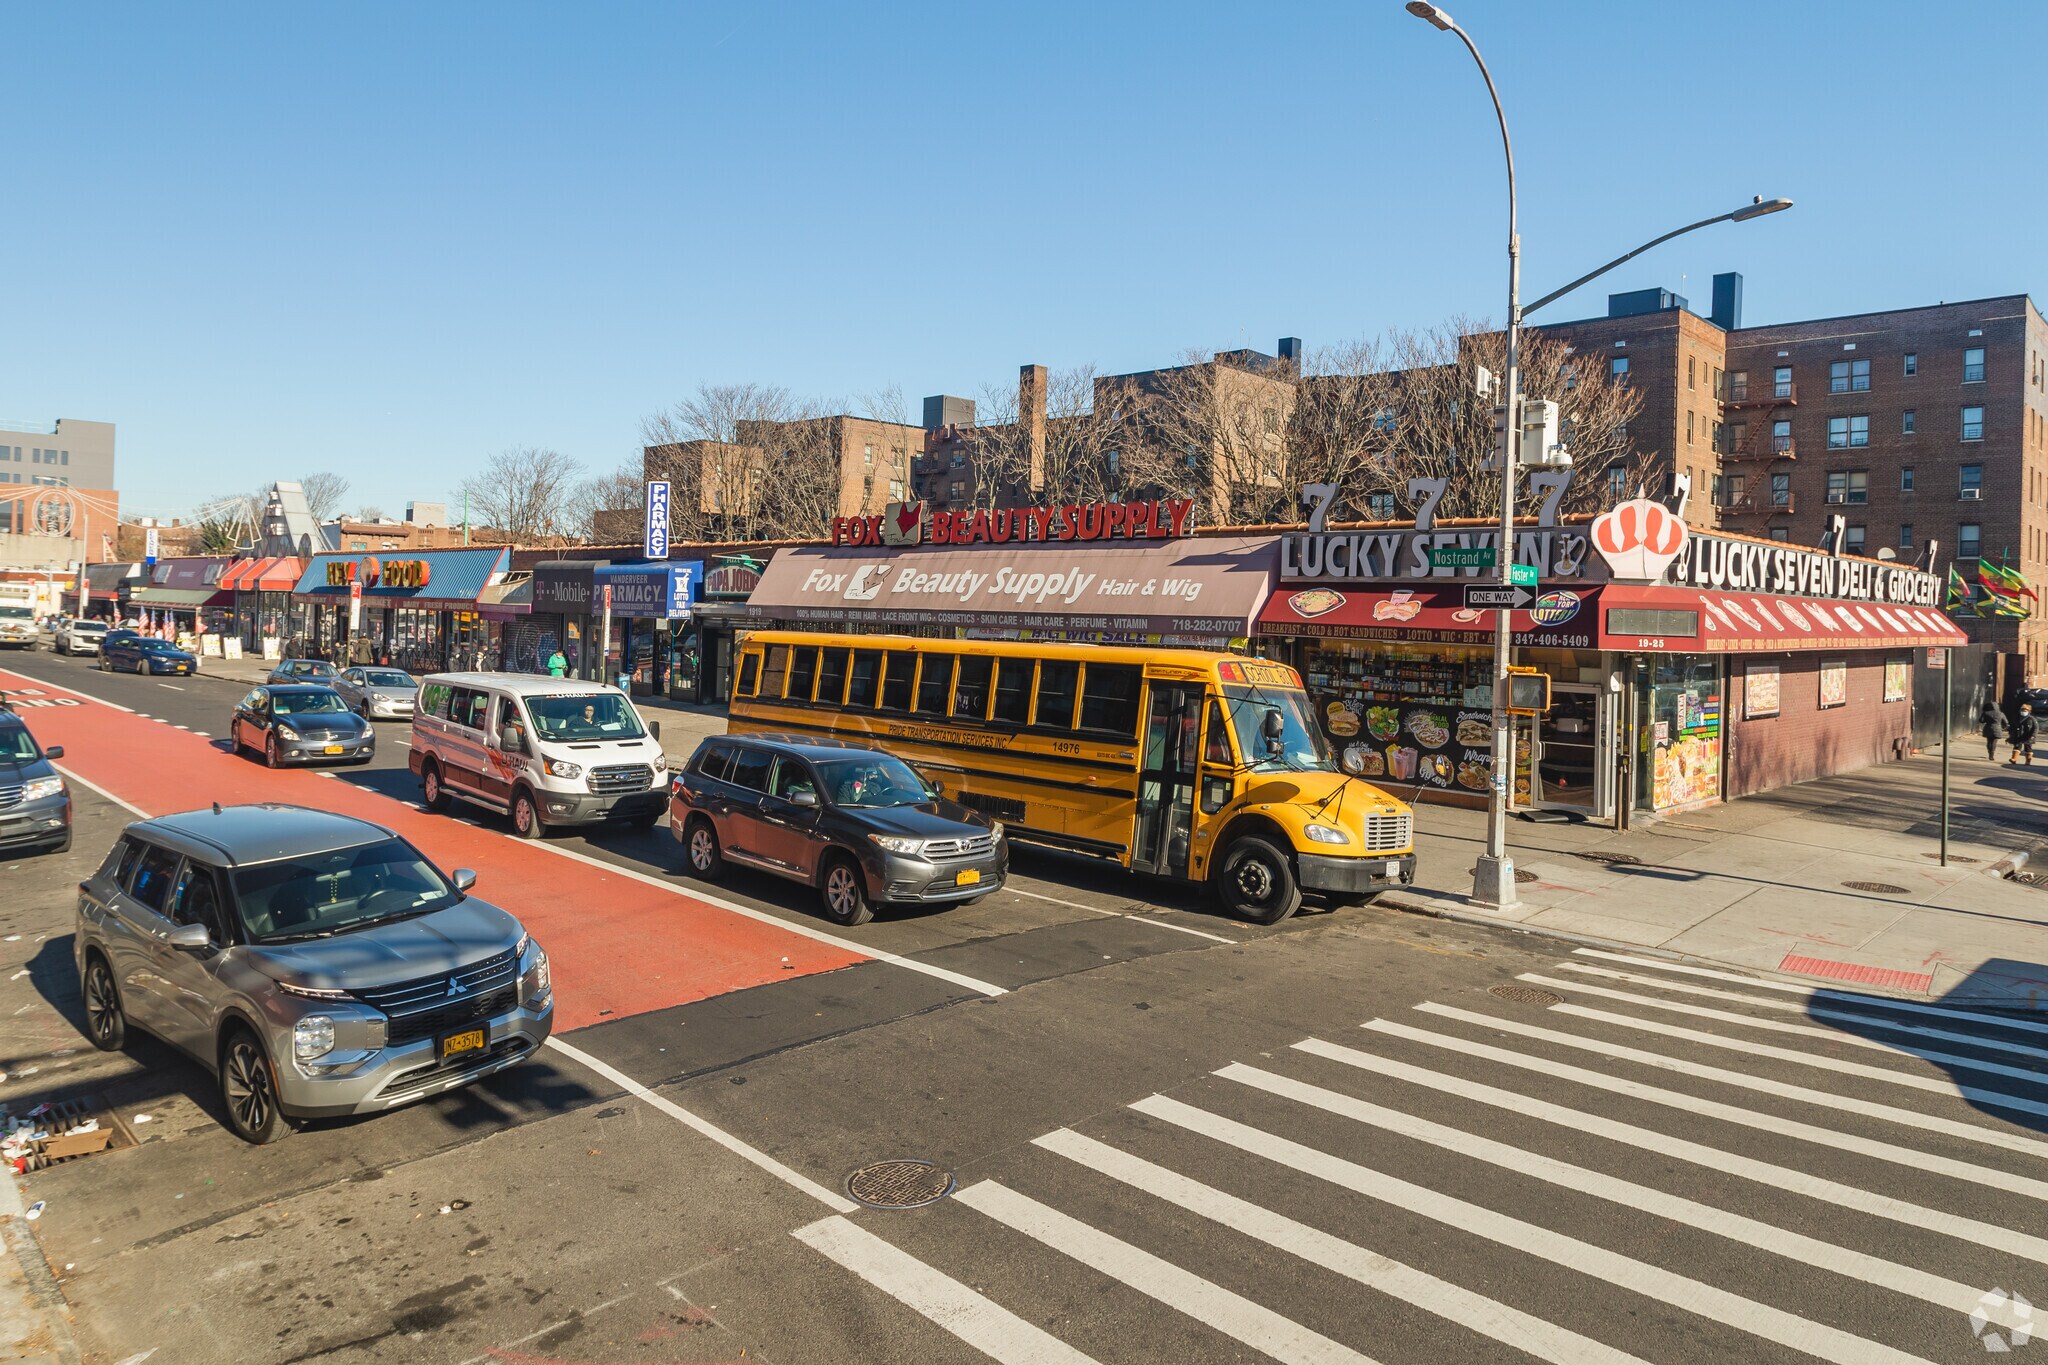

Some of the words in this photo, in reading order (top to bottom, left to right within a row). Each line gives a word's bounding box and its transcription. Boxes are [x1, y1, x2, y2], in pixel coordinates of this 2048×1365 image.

[1303, 482, 1341, 532] 7
[1408, 477, 1450, 530] 7
[1531, 470, 1575, 527] 7
[651, 484, 666, 556] PHARMACY
[832, 515, 884, 546] FOX
[931, 506, 1055, 544] BEAUTY
[1058, 499, 1194, 541] SUPPLY
[1832, 514, 1846, 557] 7
[1281, 534, 1403, 578] LUCKY
[1434, 551, 1478, 565] Nostrand
[1483, 551, 1491, 560] Av
[326, 562, 358, 587] KEY
[383, 560, 431, 588] FOOD
[610, 574, 648, 584] VANDERVEER
[1512, 567, 1529, 583] Foster
[1695, 538, 1772, 588] LUCKY
[1773, 549, 1835, 595] SEVEN
[1838, 559, 1871, 598] DELI
[1875, 569, 1884, 599] &
[1888, 571, 1941, 605] GROCERY
[707, 569, 730, 592] PAPA
[801, 568, 848, 593] Fox
[891, 568, 989, 603] Beauty
[988, 567, 1096, 604] Supply
[1097, 579, 1140, 596] Hair
[1140, 578, 1157, 596] &
[1161, 578, 1203, 601] Wig
[673, 593, 689, 601] LOTTO
[676, 601, 686, 609] FAX
[1472, 592, 1491, 602] ONE
[1494, 592, 1515, 602] WAY
[1557, 600, 1576, 608] YORK
[424, 601, 443, 609] FRESH
[444, 602, 474, 611] PRODUCE
[810, 610, 830, 619] HUMAN
[830, 610, 844, 619] HAIR
[848, 611, 861, 620] REMI
[863, 611, 877, 620] HAIR
[882, 612, 897, 620] LACE
[898, 612, 918, 621] FRONT
[919, 613, 932, 622] WIG
[938, 613, 975, 623] COSMETICS
[980, 614, 998, 624] SKIN
[999, 615, 1018, 625] CARE
[1024, 616, 1042, 626] HAIR
[1043, 616, 1064, 627] CARE
[1070, 617, 1107, 628] PERFUME
[1113, 618, 1148, 629] VITAMIN
[1533, 609, 1575, 621] LOTTERY
[1172, 619, 1242, 632] 718-282-0707
[1262, 623, 1301, 634] BREAKFAST
[1307, 625, 1326, 636] COLD
[1326, 627, 1332, 636] &
[1333, 627, 1349, 637] HOT
[1350, 628, 1398, 639] SANDWICHES
[1406, 630, 1433, 640] LOTTO
[1440, 631, 1456, 642] WIC
[1463, 632, 1480, 643] EBT
[1031, 629, 1059, 639] BIG
[1065, 630, 1096, 641] WIG
[1101, 632, 1148, 643] SALE
[1515, 633, 1589, 647] 347-406-5409
[1638, 639, 1665, 648] 19-25
[1245, 666, 1279, 683] SCHOOL
[1276, 669, 1293, 686] BUS
[888, 724, 906, 737] PRIDE
[907, 726, 961, 743] TRANSPORTATION
[961, 733, 994, 748] SERVICES
[995, 735, 1008, 749] INC.
[1053, 742, 1080, 755] 14976
[501, 754, 529, 772] U-HAUL
